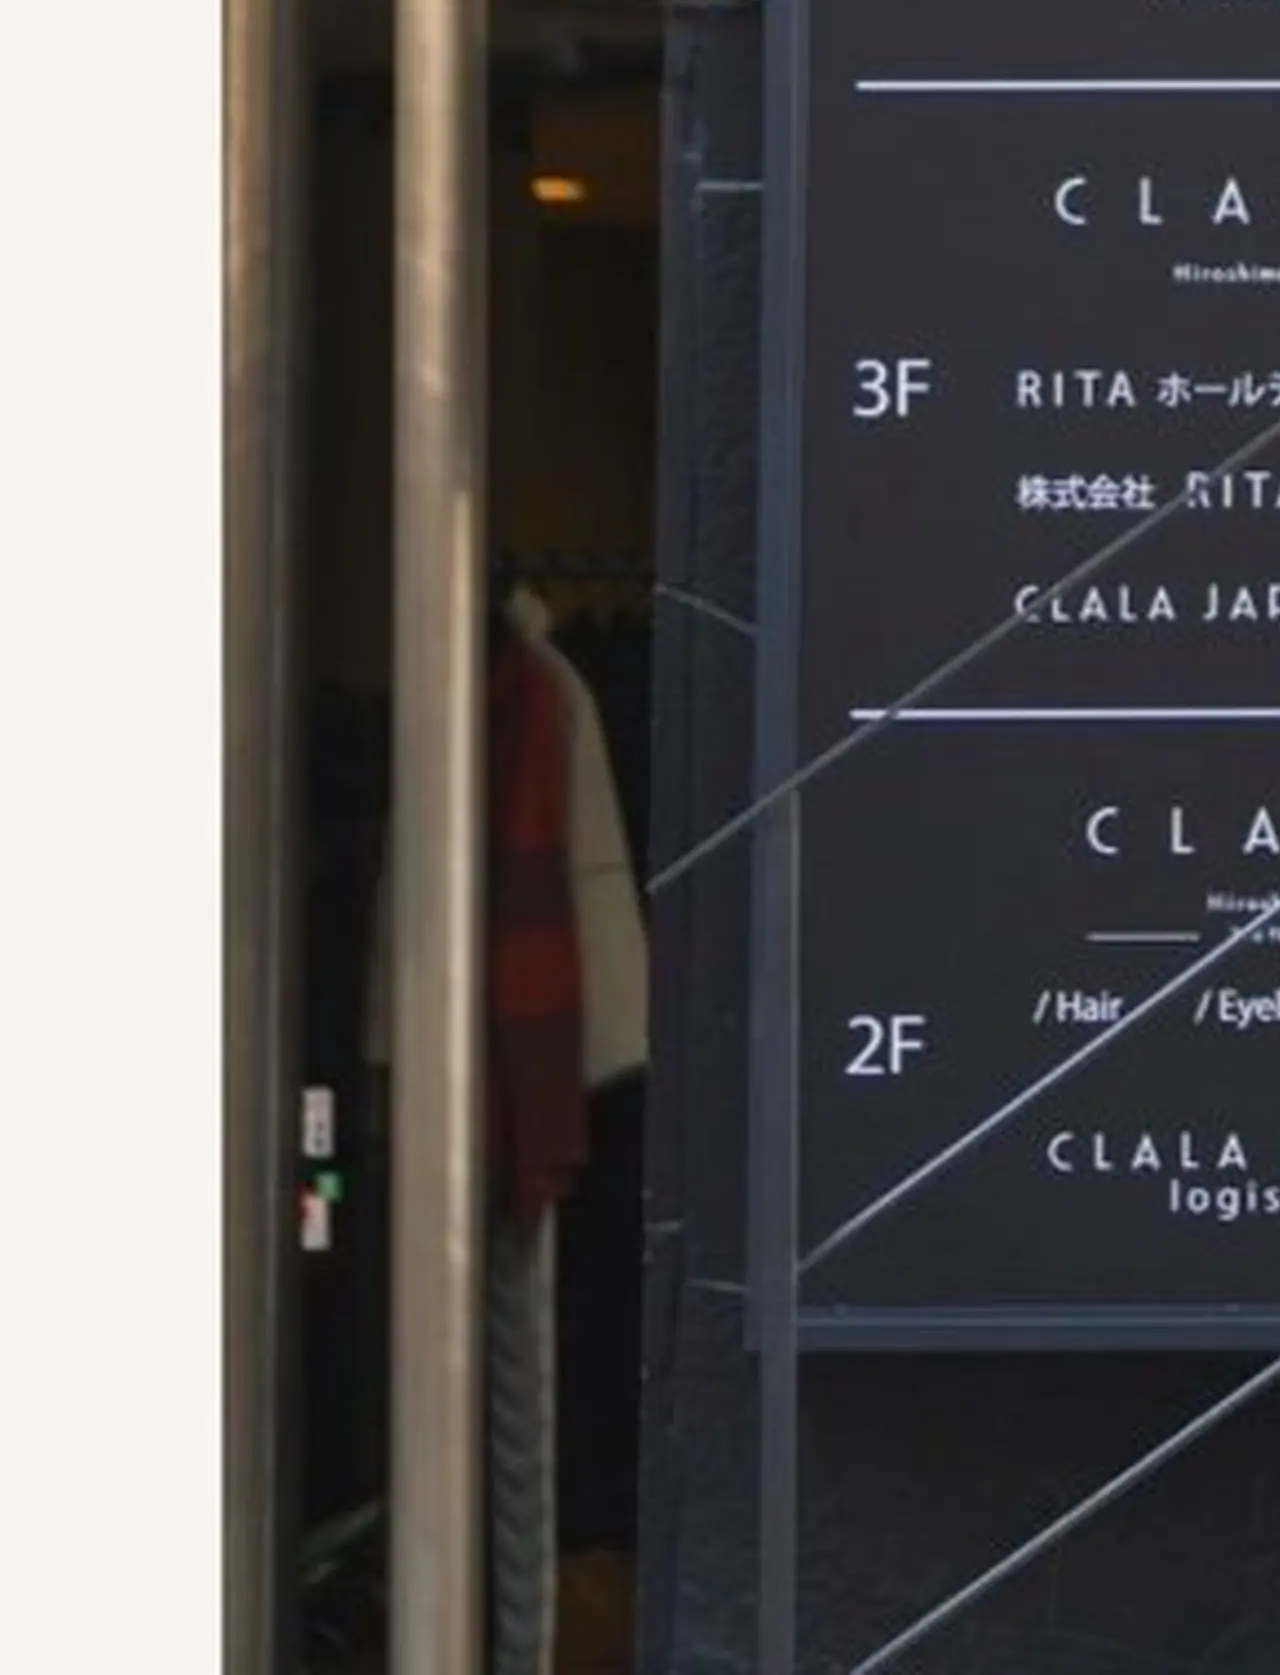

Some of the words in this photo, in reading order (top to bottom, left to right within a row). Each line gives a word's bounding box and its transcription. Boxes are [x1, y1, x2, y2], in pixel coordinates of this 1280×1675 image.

[852, 358, 931, 418] 3F
[1016, 369, 1136, 408] RITA
[1017, 473, 1155, 511] 株式会社
[1014, 583, 1176, 623] CLALA
[844, 1015, 926, 1076] 2F
[1046, 1131, 1247, 1172] CLALA
